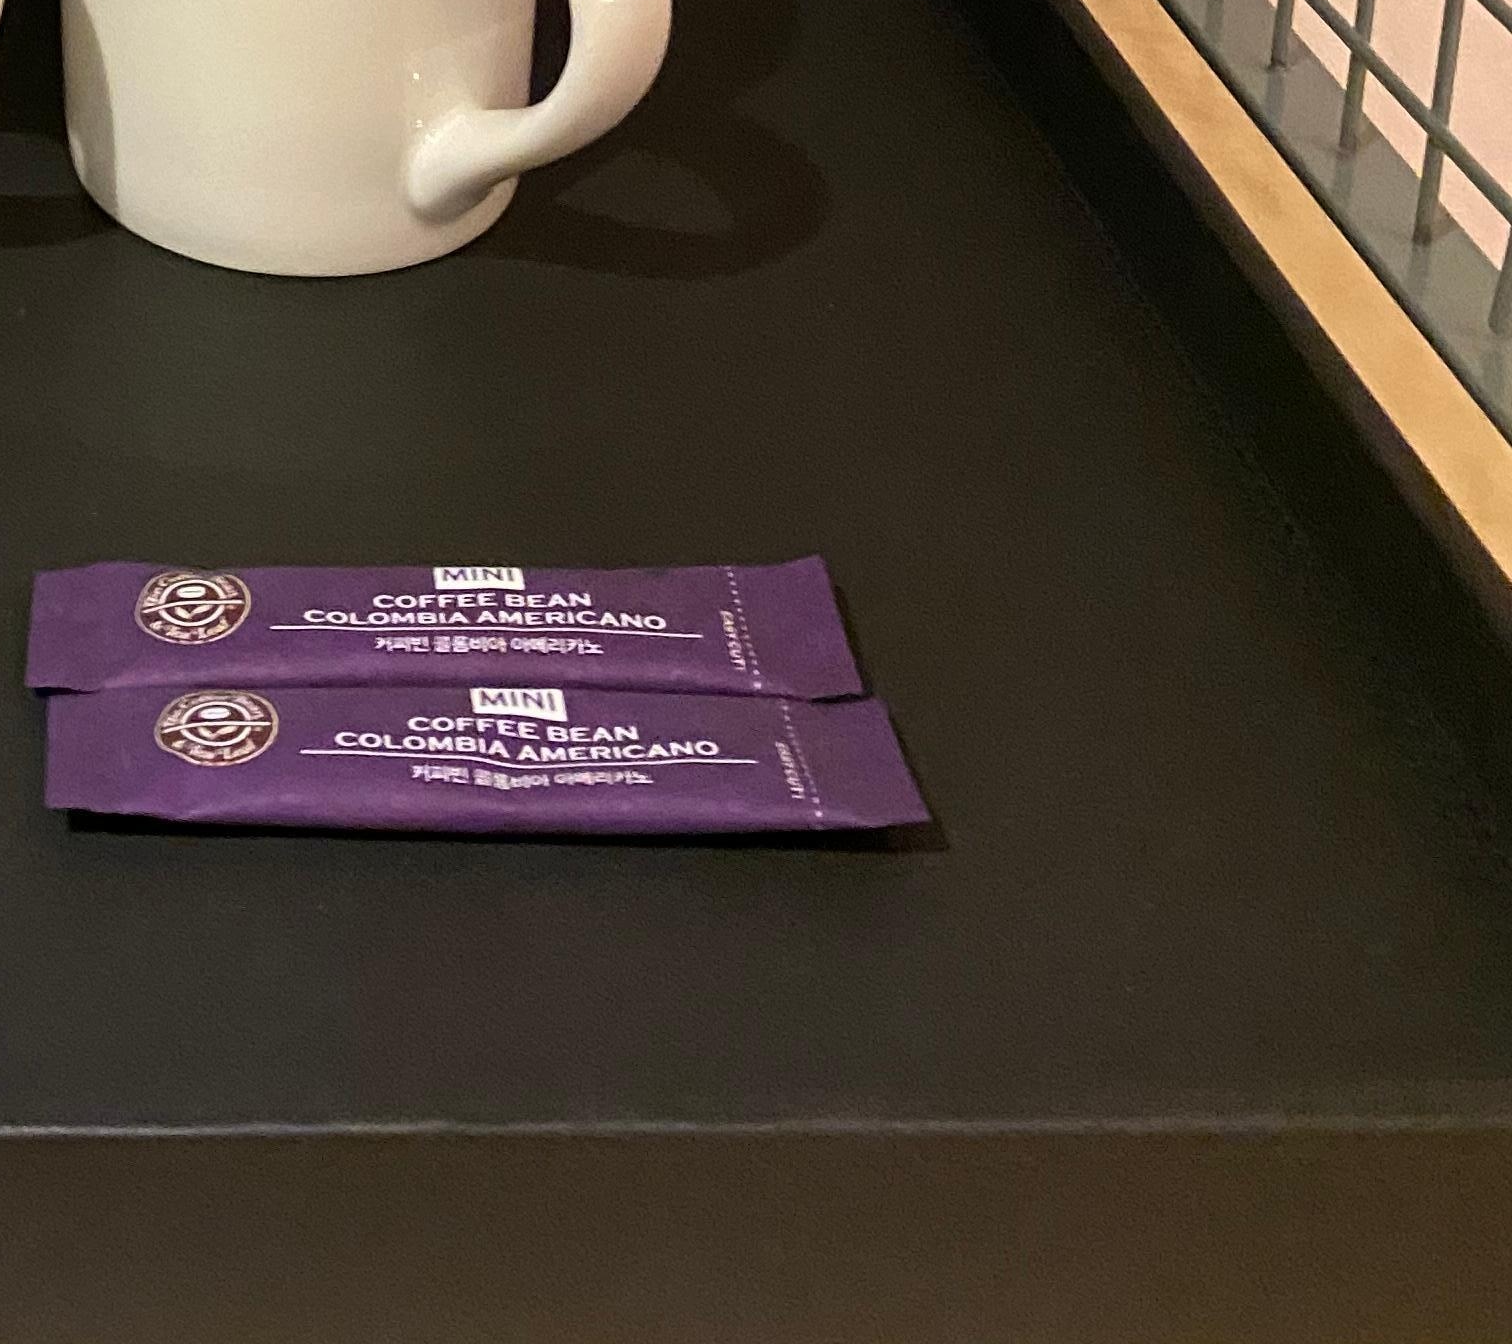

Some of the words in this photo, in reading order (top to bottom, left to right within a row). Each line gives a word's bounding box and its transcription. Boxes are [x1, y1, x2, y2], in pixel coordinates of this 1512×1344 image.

[441, 567, 516, 583] MINI
[372, 592, 498, 609] COFFEE
[503, 592, 592, 609] BEAN
[302, 609, 470, 627] COLOMBIA
[475, 610, 668, 631] AMERICANO
[478, 690, 558, 712] MINI
[407, 716, 541, 741] COFFEE
[545, 724, 640, 743] BEAN
[334, 730, 510, 759] COLOMBIA
[516, 739, 721, 763] AMERICANO
